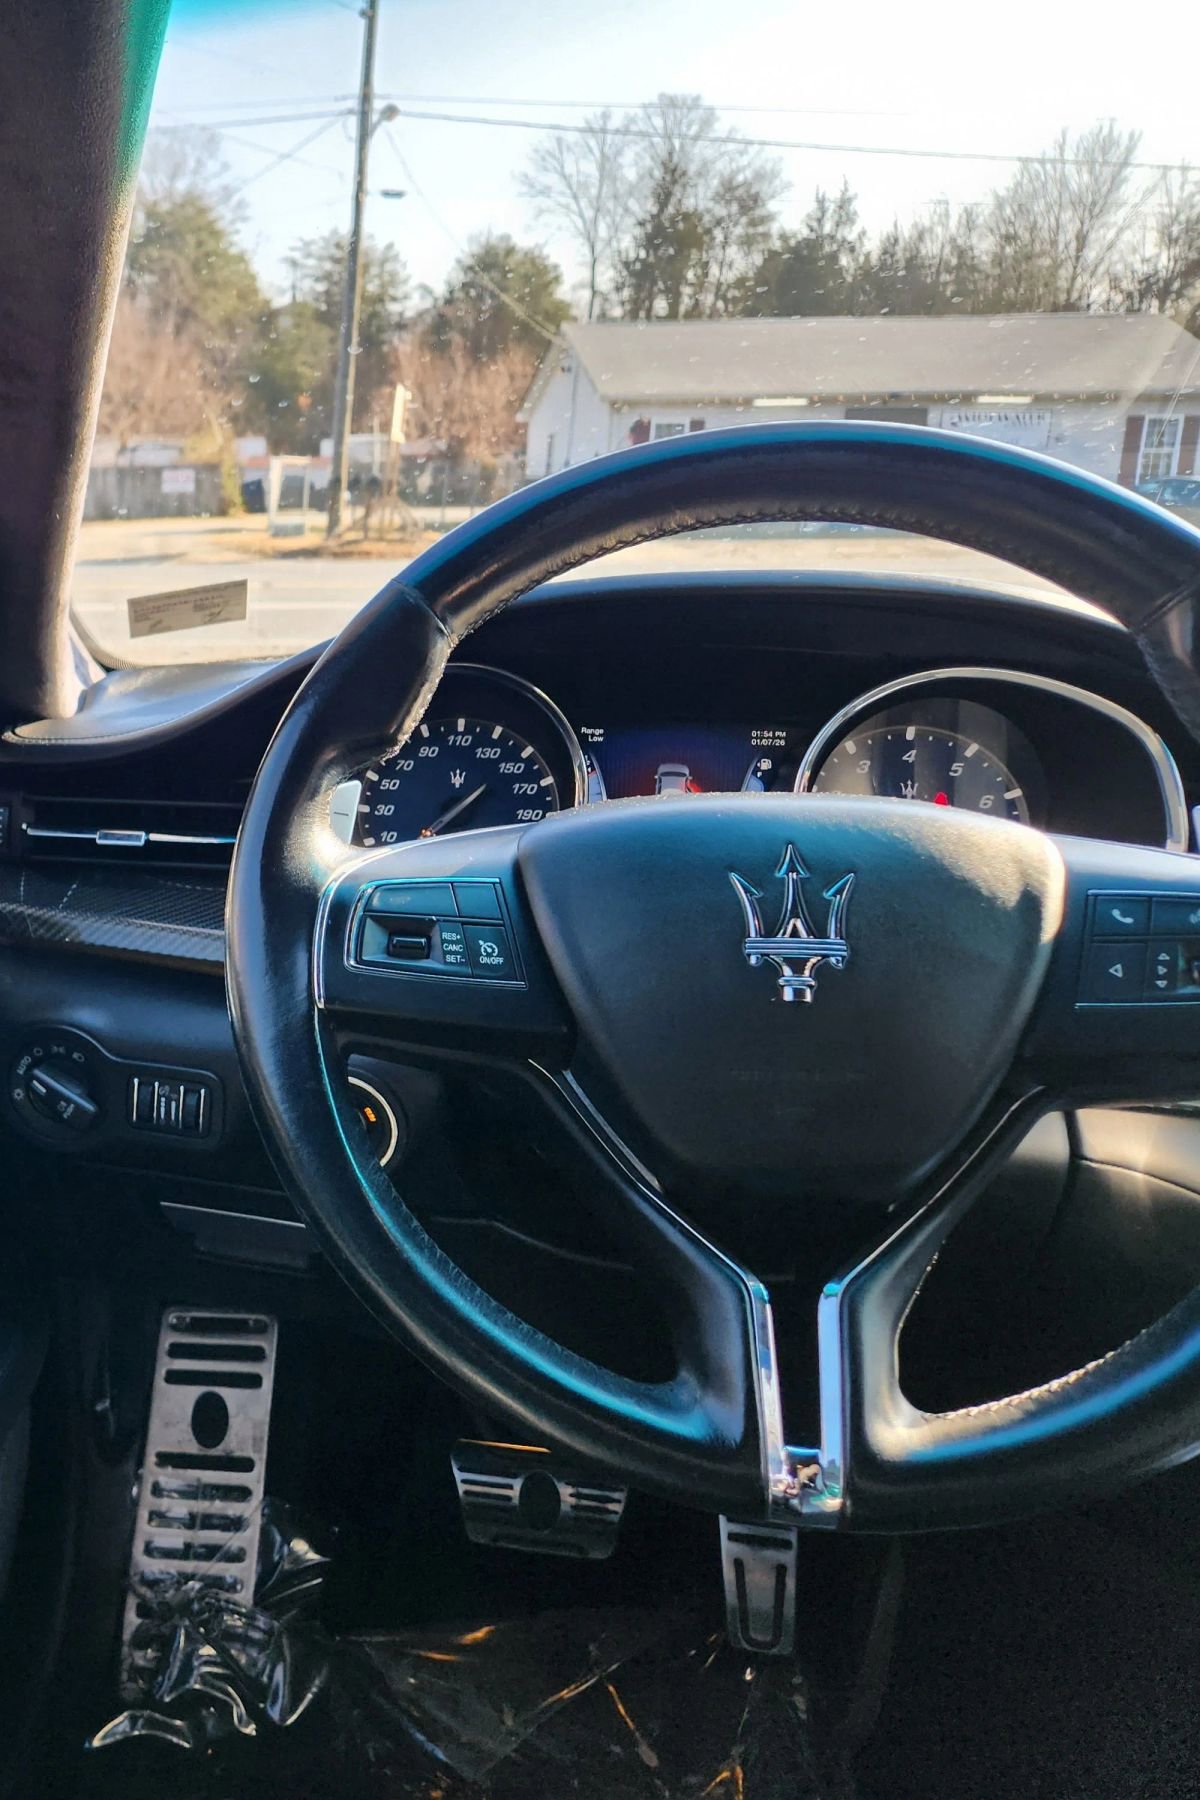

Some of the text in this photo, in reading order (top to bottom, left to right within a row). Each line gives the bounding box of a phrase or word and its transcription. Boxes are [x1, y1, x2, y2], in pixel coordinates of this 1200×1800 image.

[581, 727, 604, 735] Range
[447, 735, 472, 746] 110
[751, 738, 785, 746] 01/07/26
[418, 747, 439, 757] 90
[475, 748, 501, 759] 130
[902, 750, 917, 763] 4
[395, 760, 414, 771] 70
[498, 763, 524, 774] 150
[856, 760, 870, 774] 3
[949, 763, 964, 777] 5
[380, 779, 400, 790] 50
[511, 784, 538, 795] 170
[979, 795, 994, 809] 6
[374, 805, 395, 816] 30
[515, 809, 543, 821] 190
[380, 832, 398, 843] 10
[442, 932, 461, 940] RES+
[443, 943, 463, 951] CANC
[480, 956, 504, 964] ON/OFF
[16, 1056, 31, 1075] AUTO
